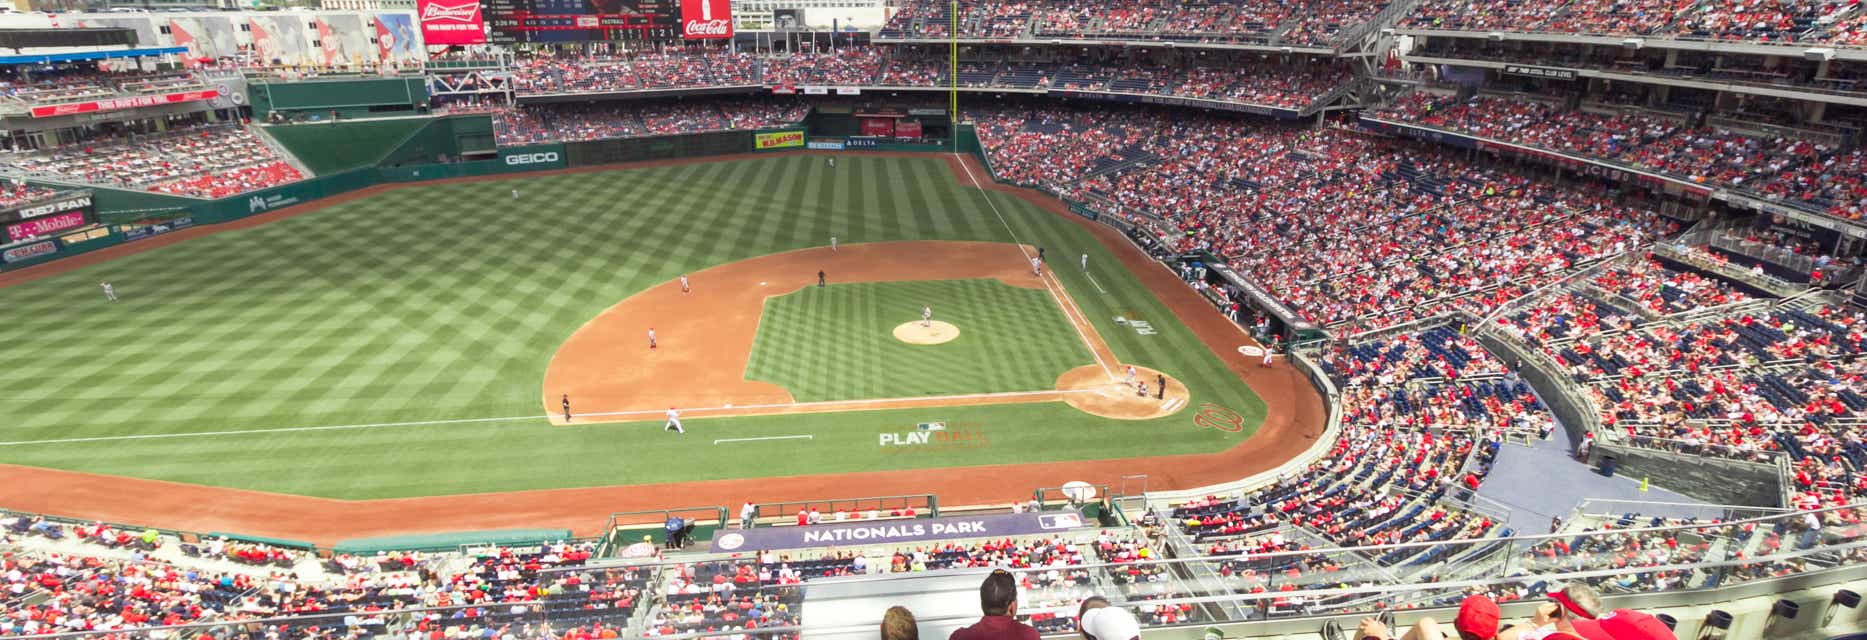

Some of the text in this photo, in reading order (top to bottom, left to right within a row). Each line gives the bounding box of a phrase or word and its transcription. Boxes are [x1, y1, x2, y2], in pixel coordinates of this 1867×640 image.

[425, 6, 474, 17] Budweiser
[685, 19, 730, 35] Coca-Cola
[505, 152, 558, 165] GEICO
[57, 197, 91, 211] FAN
[879, 431, 931, 446] PLAY
[803, 520, 987, 543] NATIONALS PARK
